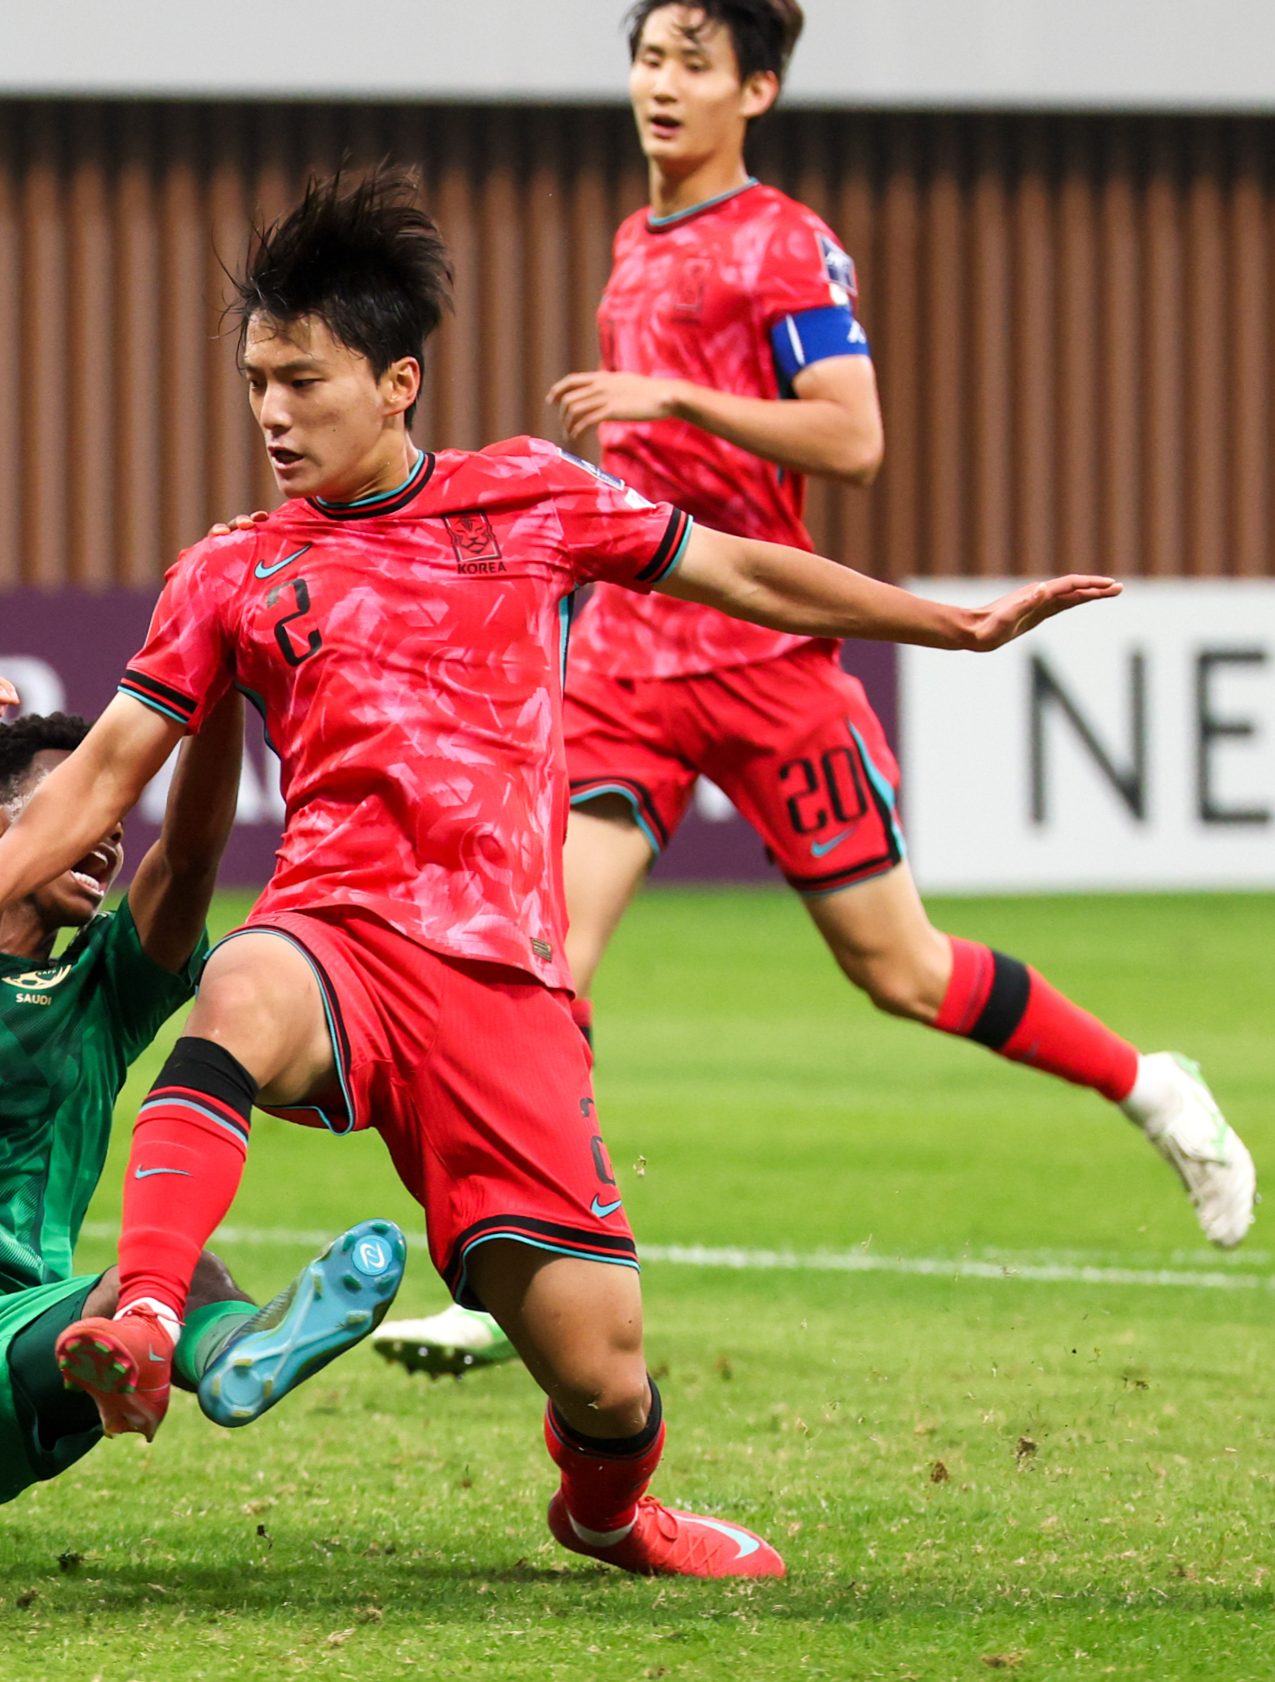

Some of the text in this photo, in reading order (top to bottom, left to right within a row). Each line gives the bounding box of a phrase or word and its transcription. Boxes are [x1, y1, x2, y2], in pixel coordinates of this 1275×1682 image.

[457, 561, 507, 574] KOREA
[266, 578, 323, 668] 2
[779, 747, 869, 835] 20
[15, 993, 52, 1005] SAUDI
